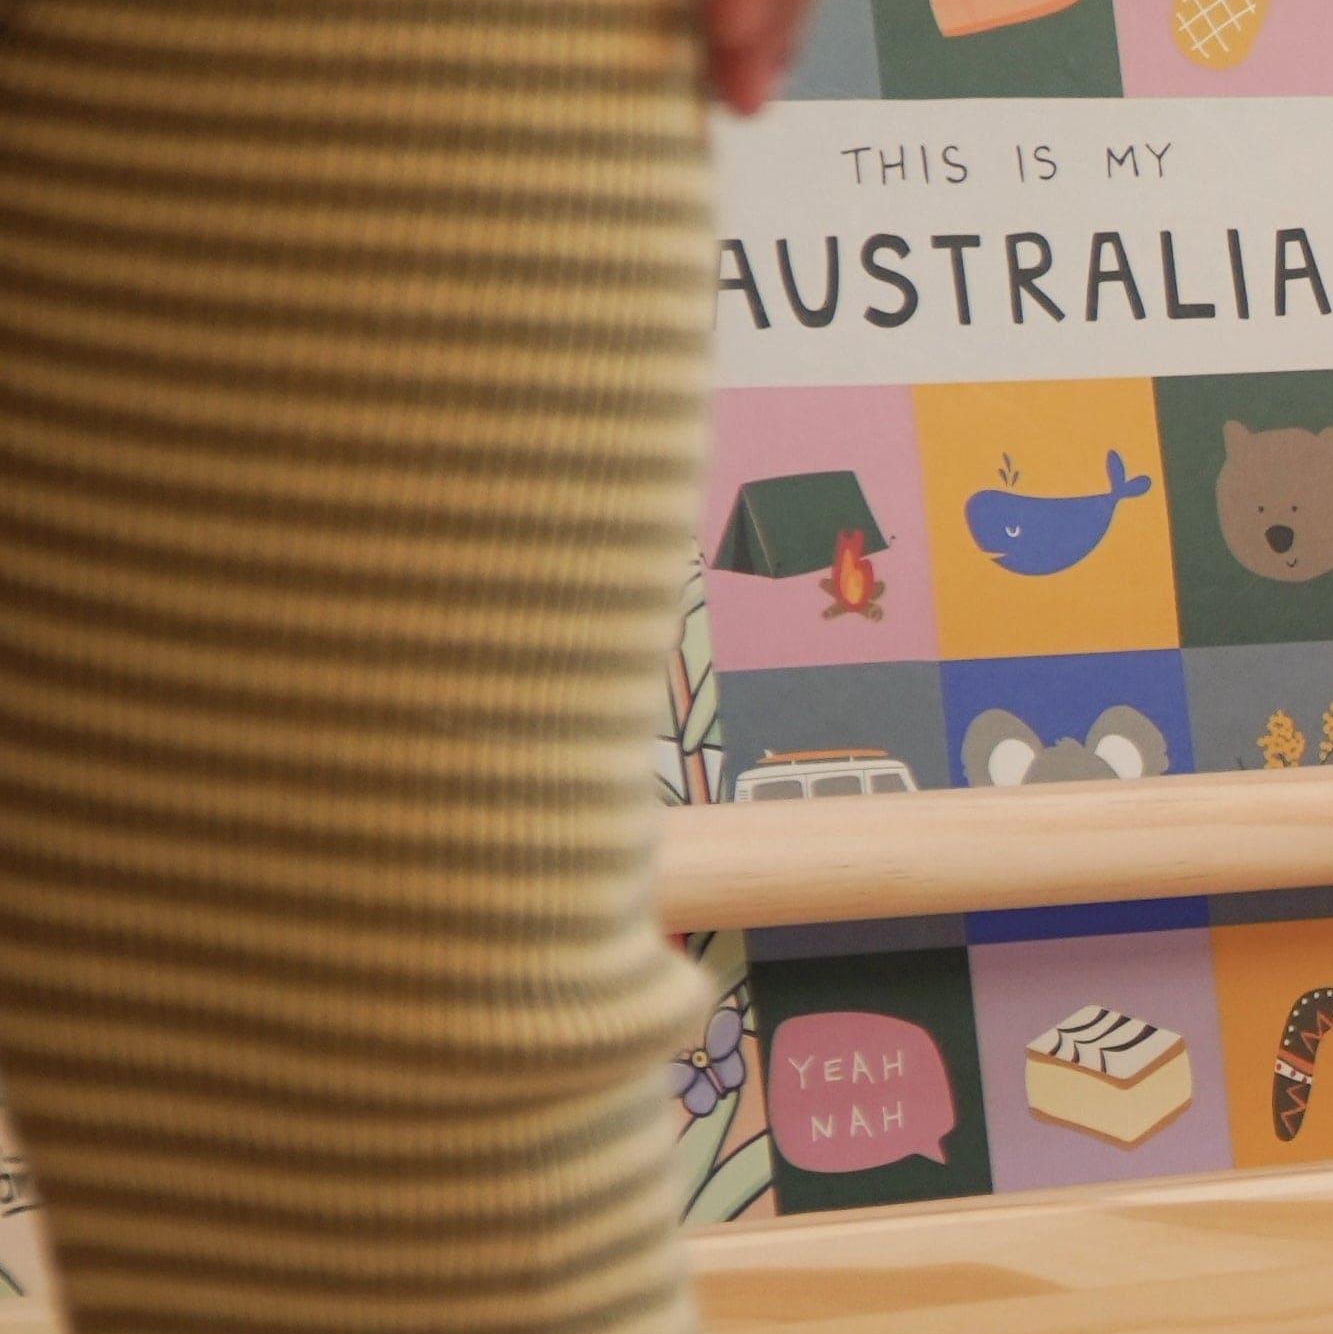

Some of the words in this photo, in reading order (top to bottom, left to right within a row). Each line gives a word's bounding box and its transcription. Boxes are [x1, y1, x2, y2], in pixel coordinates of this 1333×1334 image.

[841, 144, 968, 185] THIS
[1015, 144, 1058, 182] IS
[1105, 142, 1172, 178] MY
[714, 227, 1332, 329] AUSTRALIA
[787, 1049, 905, 1091] YEAH
[810, 1102, 905, 1142] NAH
